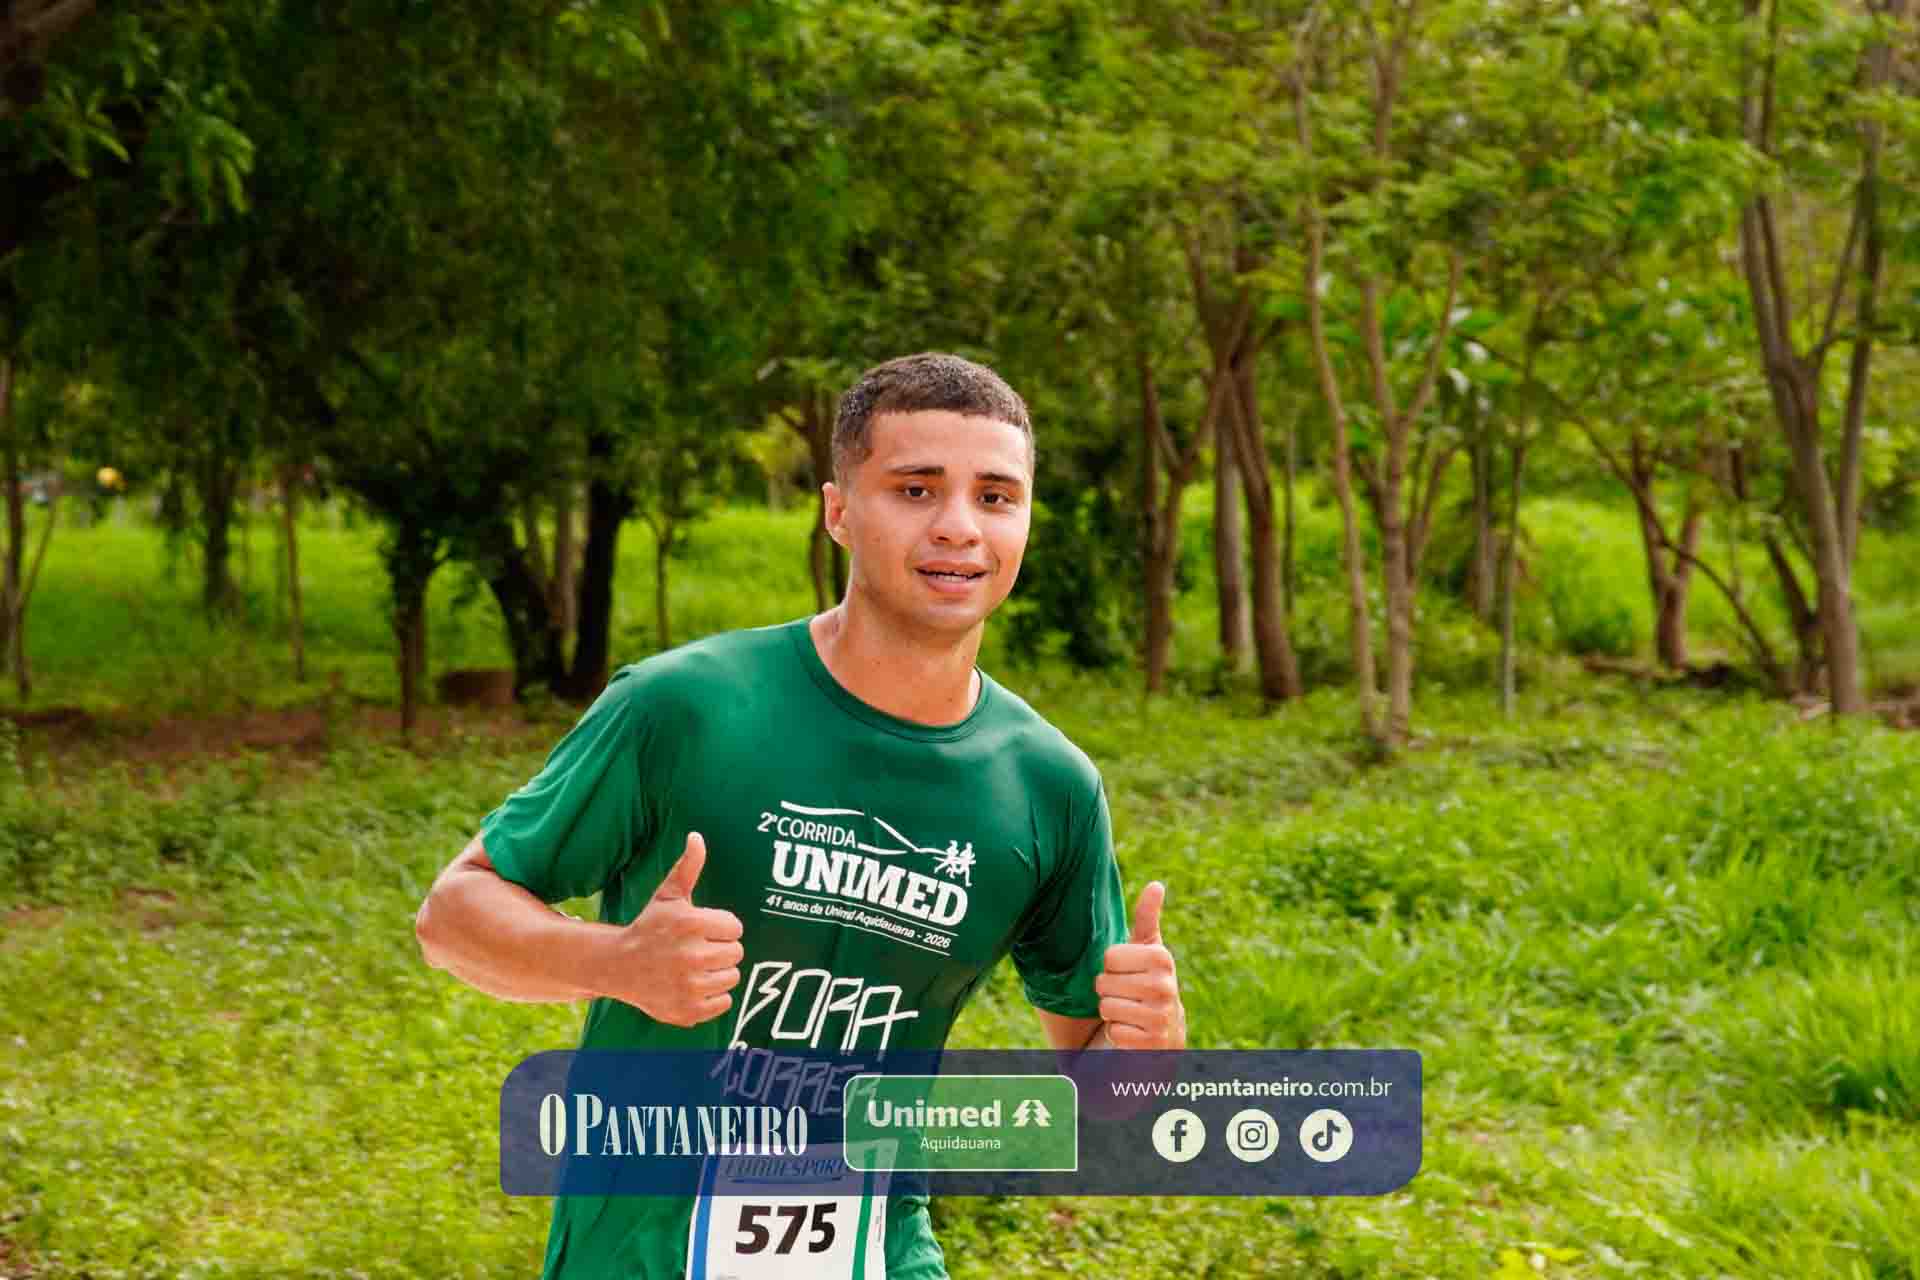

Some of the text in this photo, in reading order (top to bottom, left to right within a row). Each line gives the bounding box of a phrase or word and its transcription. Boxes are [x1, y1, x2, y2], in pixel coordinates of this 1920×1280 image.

[777, 816, 857, 848] CORRIDA
[772, 840, 969, 926] UNIMED
[765, 894, 783, 907] 41
[783, 899, 809, 912] anos
[854, 910, 916, 938] Aquidauana
[923, 931, 952, 949] 2026
[728, 961, 919, 1062] BORA
[735, 1202, 837, 1255] 575
